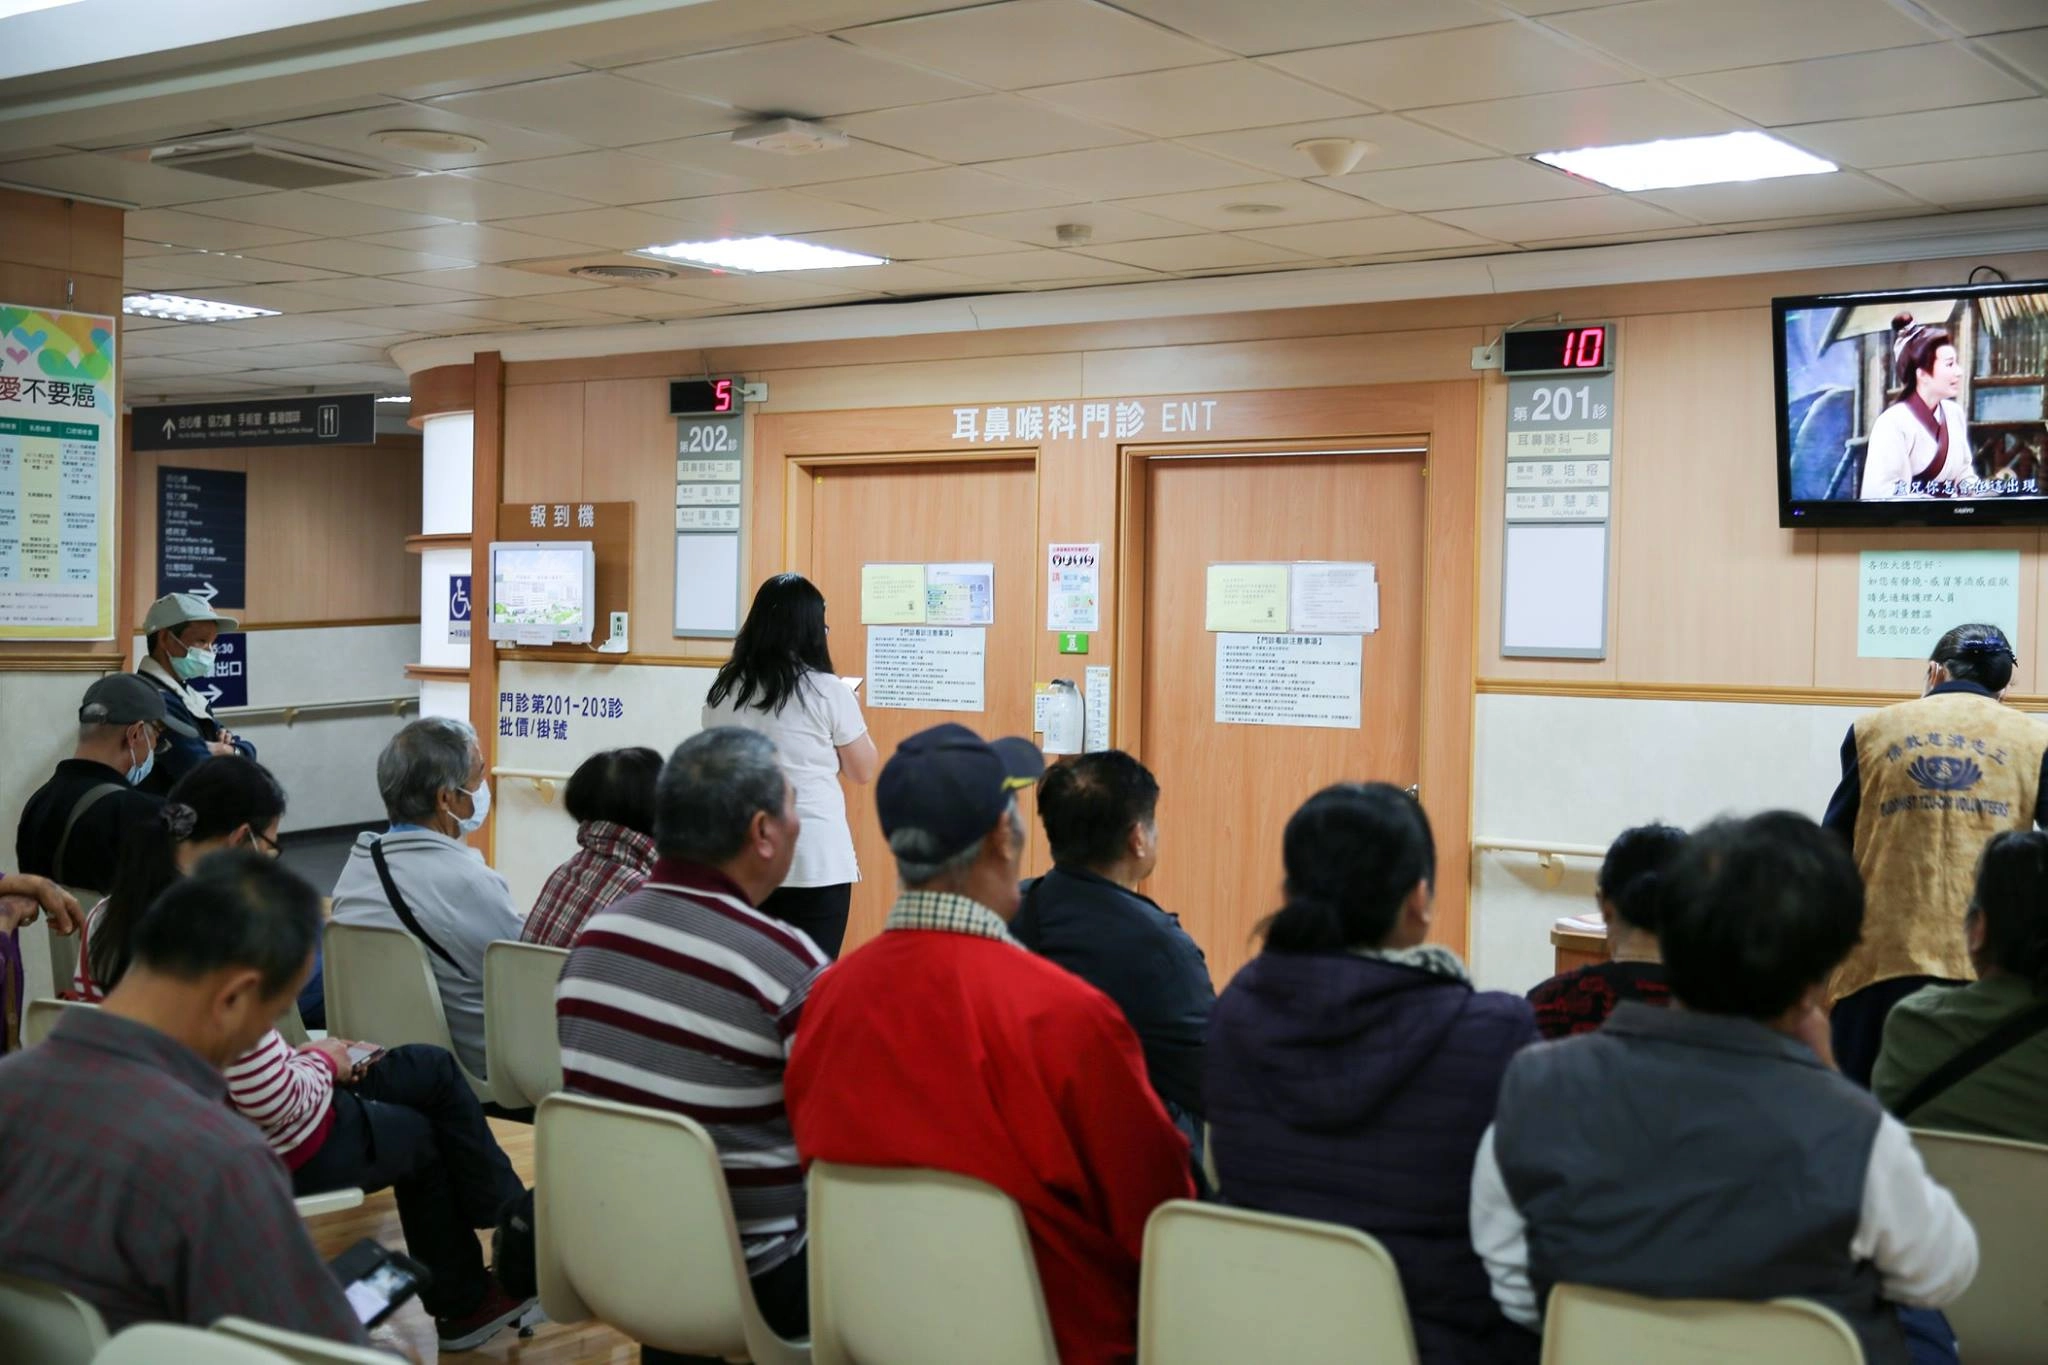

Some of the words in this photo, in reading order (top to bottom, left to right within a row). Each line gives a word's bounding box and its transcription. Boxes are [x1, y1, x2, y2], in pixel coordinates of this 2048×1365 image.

[1563, 329, 1603, 367] 10
[715, 381, 731, 411] 5
[952, 402, 1145, 442] 耳鼻喉科門診
[1161, 400, 1217, 433] ENT
[530, 504, 595, 528] 報到機
[500, 692, 623, 719] 門診第201-203診
[499, 716, 568, 741] 批價/掛號
